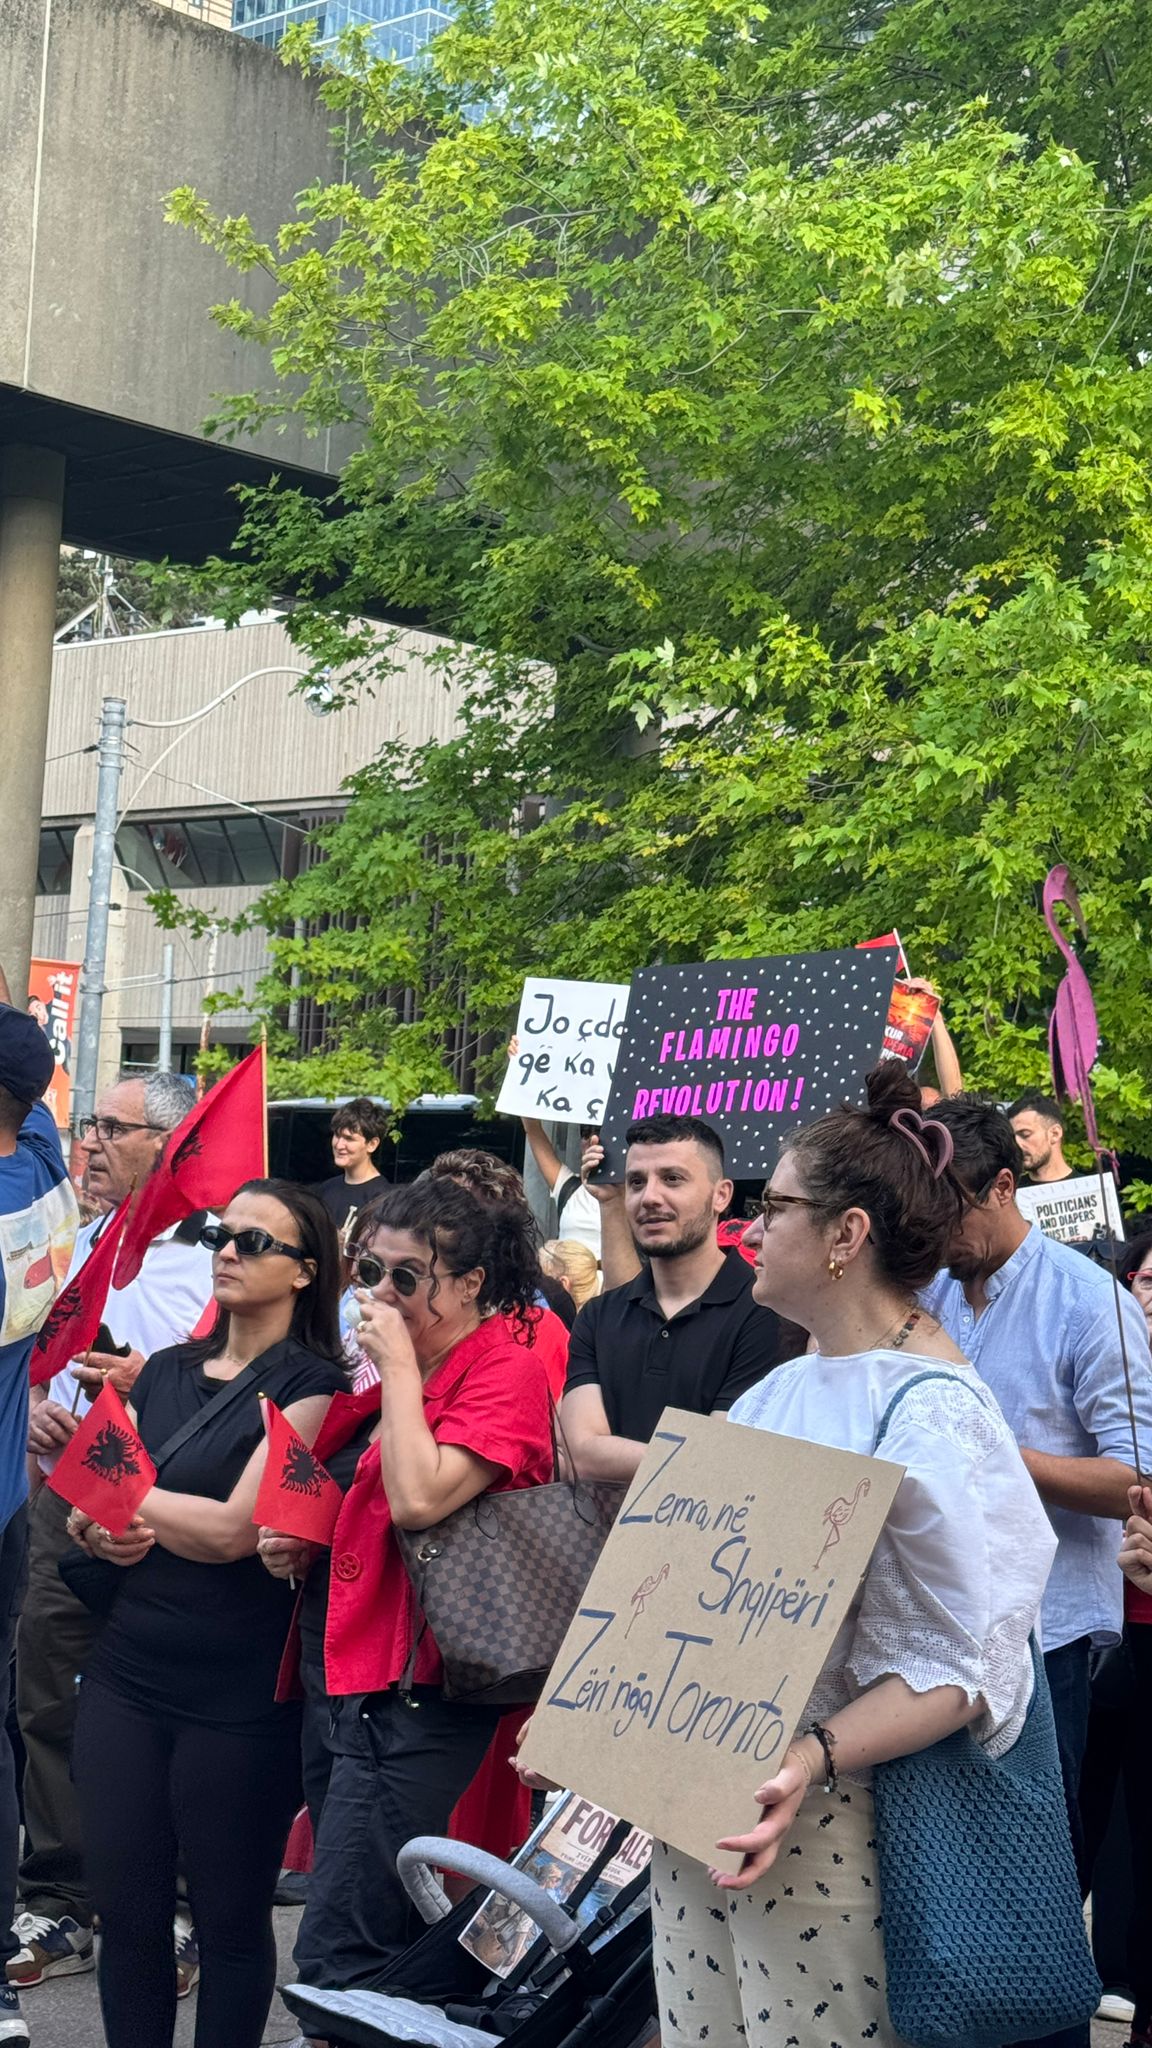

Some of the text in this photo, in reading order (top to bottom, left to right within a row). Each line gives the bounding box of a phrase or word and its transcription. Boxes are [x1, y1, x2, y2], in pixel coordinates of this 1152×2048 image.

[524, 993, 570, 1035] Jo
[716, 988, 758, 1021] THE
[659, 1023, 800, 1064] FLAMINGO
[631, 1076, 805, 1121] REVOLUTION!
[1036, 1194, 1098, 1219] POLITICIANS
[1040, 1208, 1096, 1231] AND DIAPERS
[1068, 1225, 1080, 1237] BE
[619, 1431, 756, 1533] Zemra në
[698, 1535, 835, 1646] Shqipëri
[547, 1608, 617, 1712] Zëri
[648, 1630, 784, 1762] Toronto
[561, 1799, 653, 1870] FOR ALE
